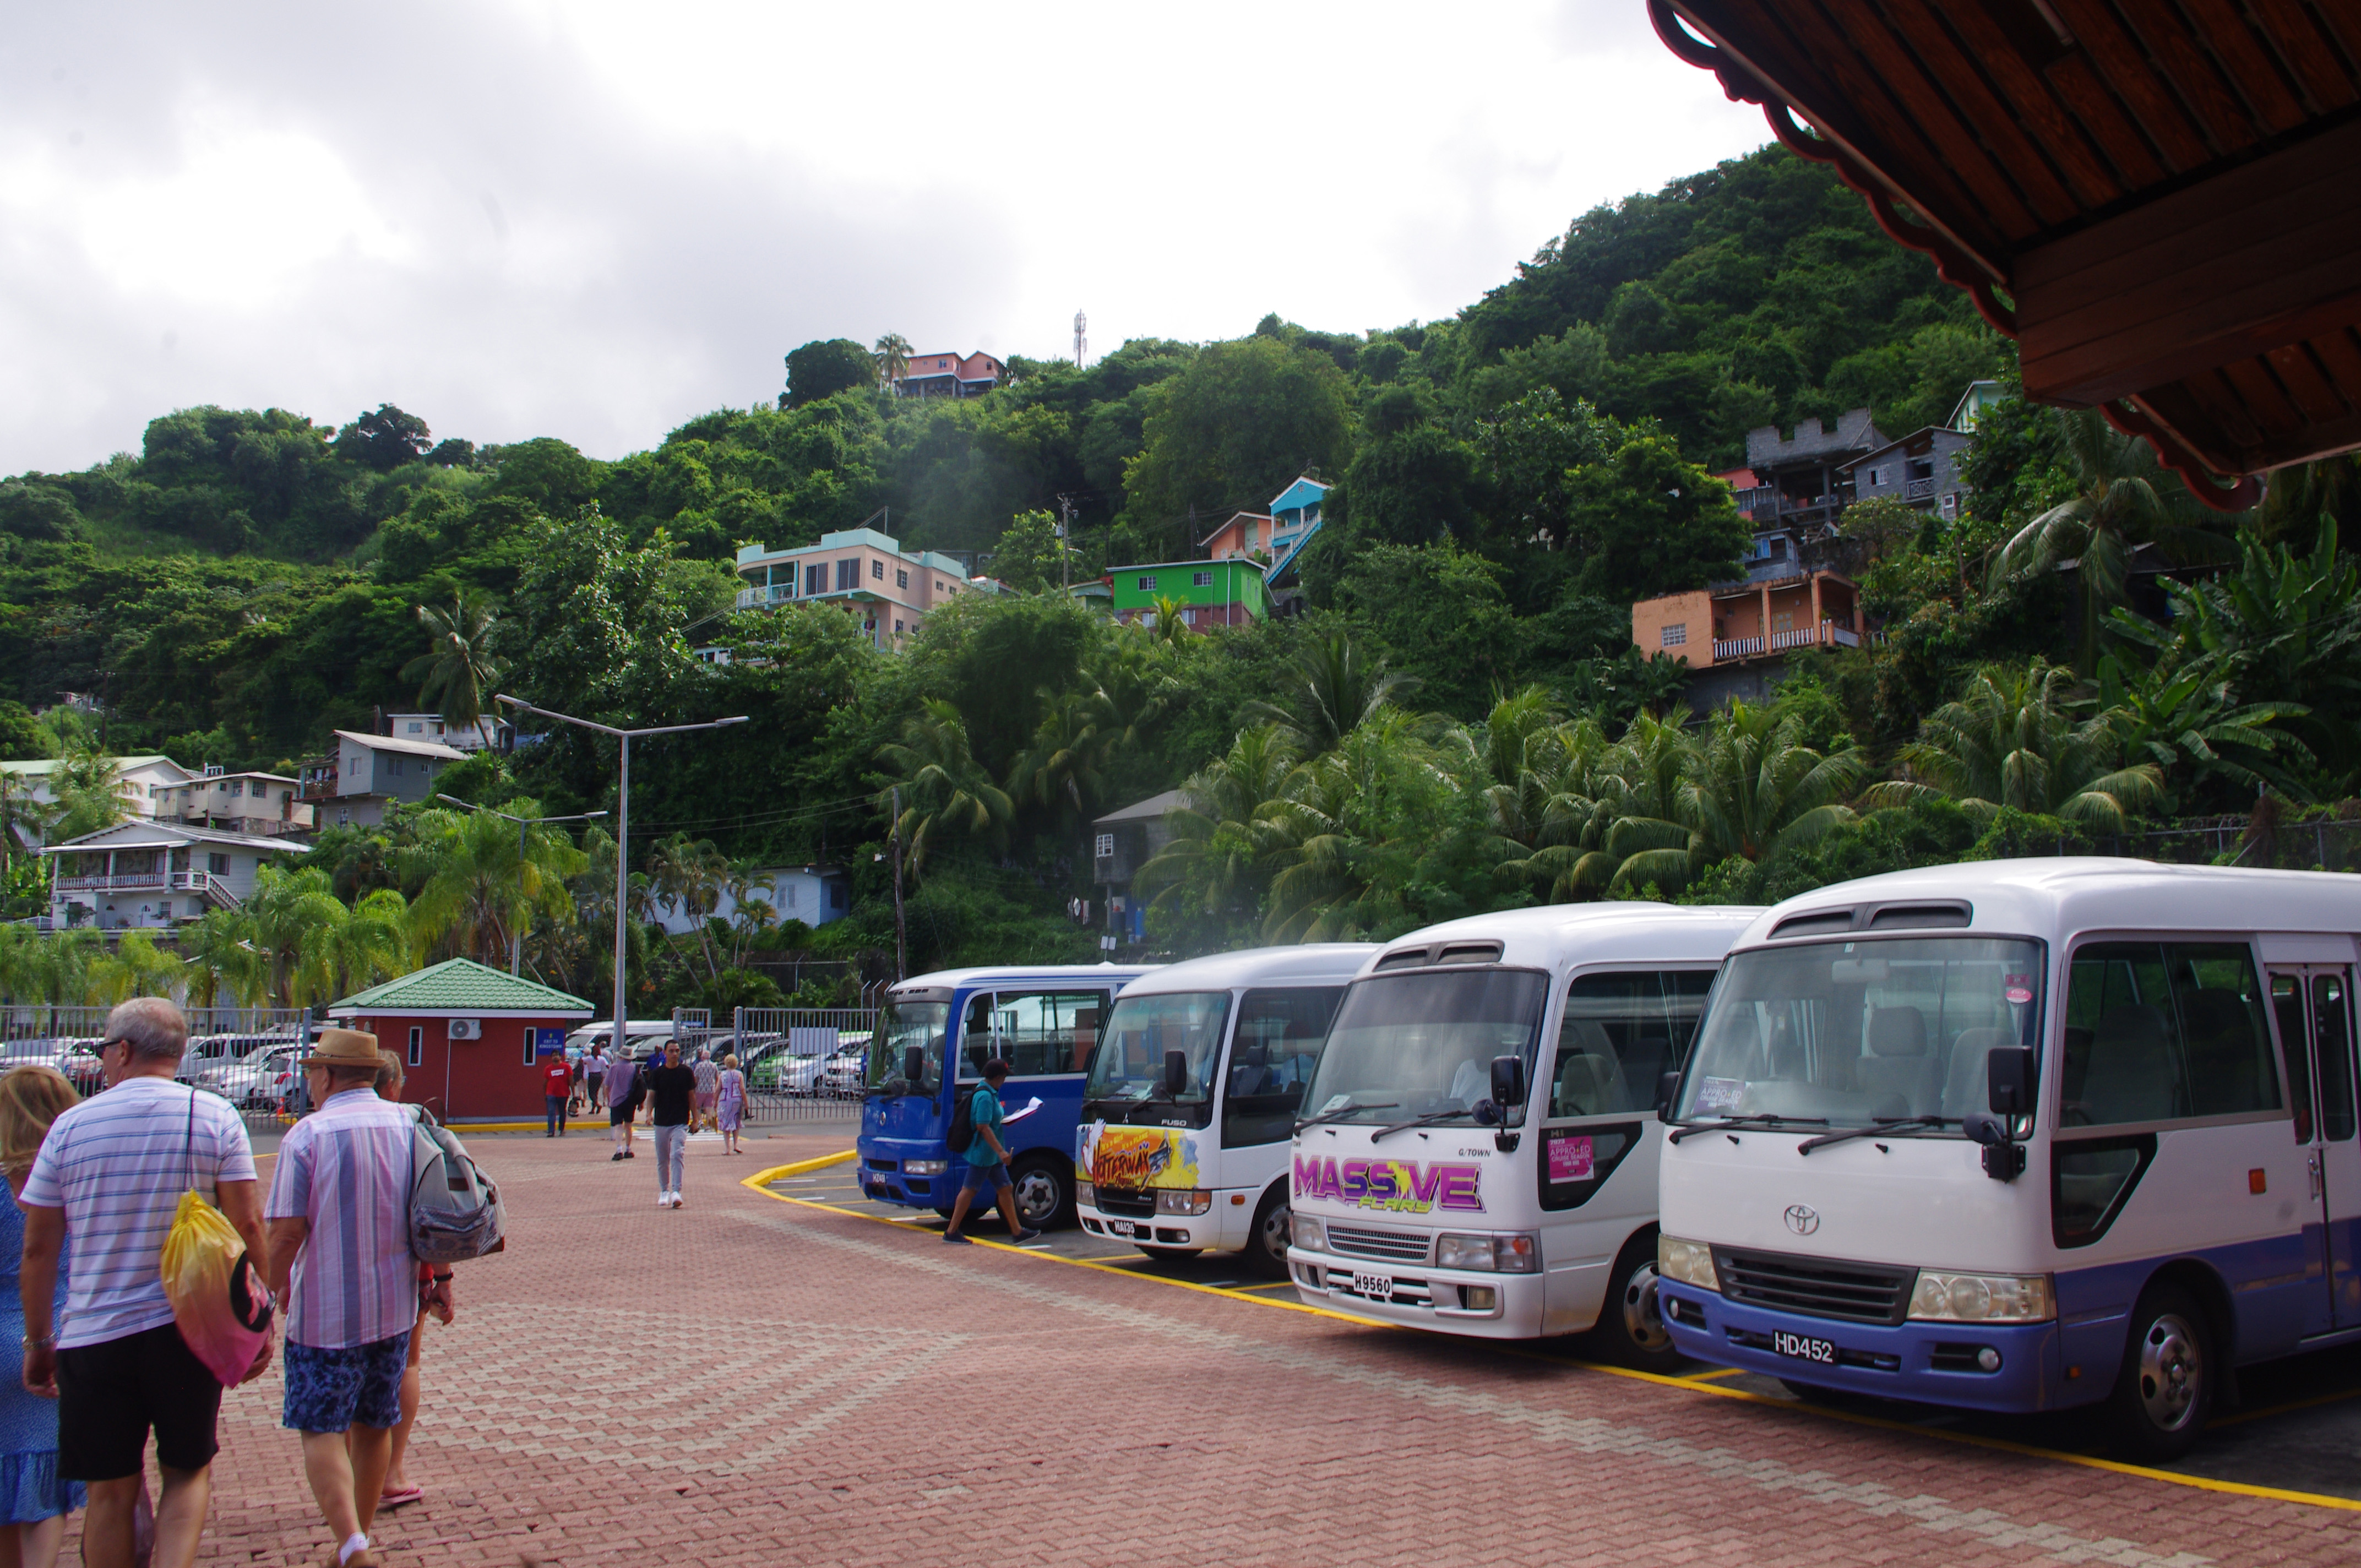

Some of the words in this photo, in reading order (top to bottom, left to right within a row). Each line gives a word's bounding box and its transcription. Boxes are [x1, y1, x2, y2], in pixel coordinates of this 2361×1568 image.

[1161, 1118, 1187, 1126] FUSO
[1459, 1148, 1491, 1157] G/TOWN
[1354, 1274, 1390, 1294] H9560
[1775, 1331, 1834, 1364] HD452
